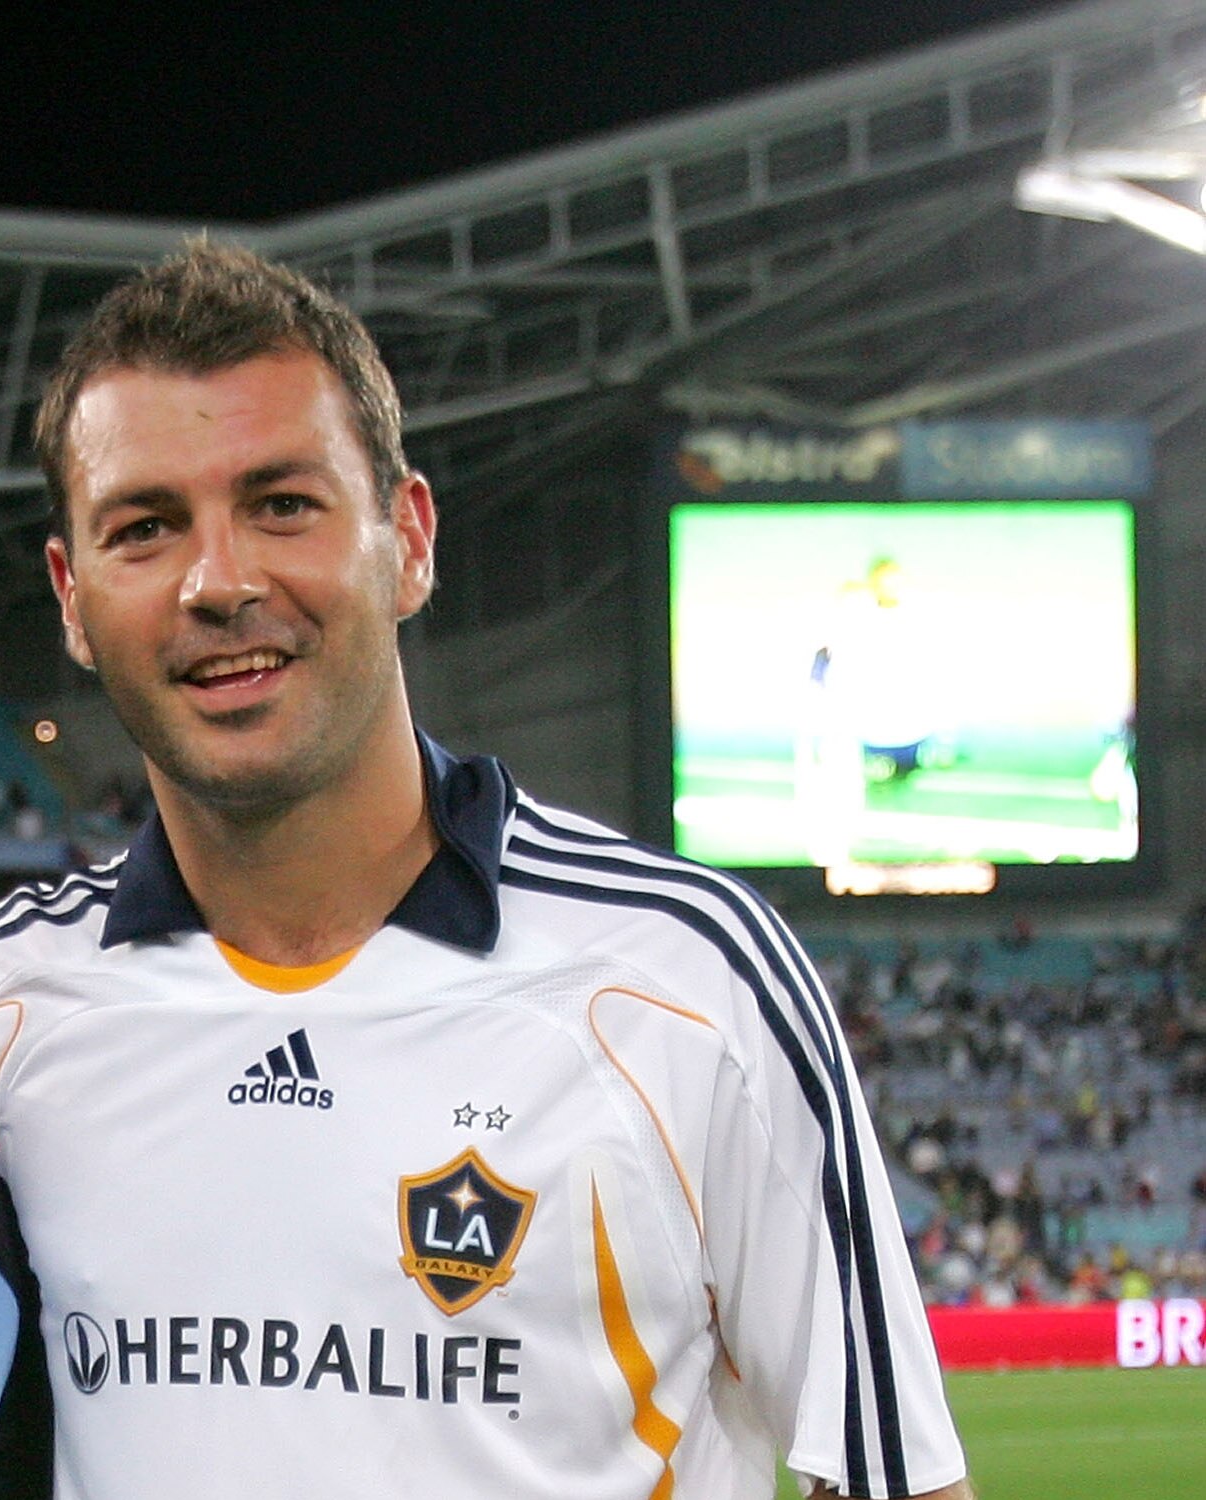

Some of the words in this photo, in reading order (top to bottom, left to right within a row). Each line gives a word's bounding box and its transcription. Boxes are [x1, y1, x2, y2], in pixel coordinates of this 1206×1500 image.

[227, 1077, 334, 1110] adidas
[425, 1207, 494, 1257] LA
[415, 1259, 494, 1278] GALAXY
[1115, 1297, 1206, 1368] BR
[115, 1317, 521, 1404] HERBALIFE
